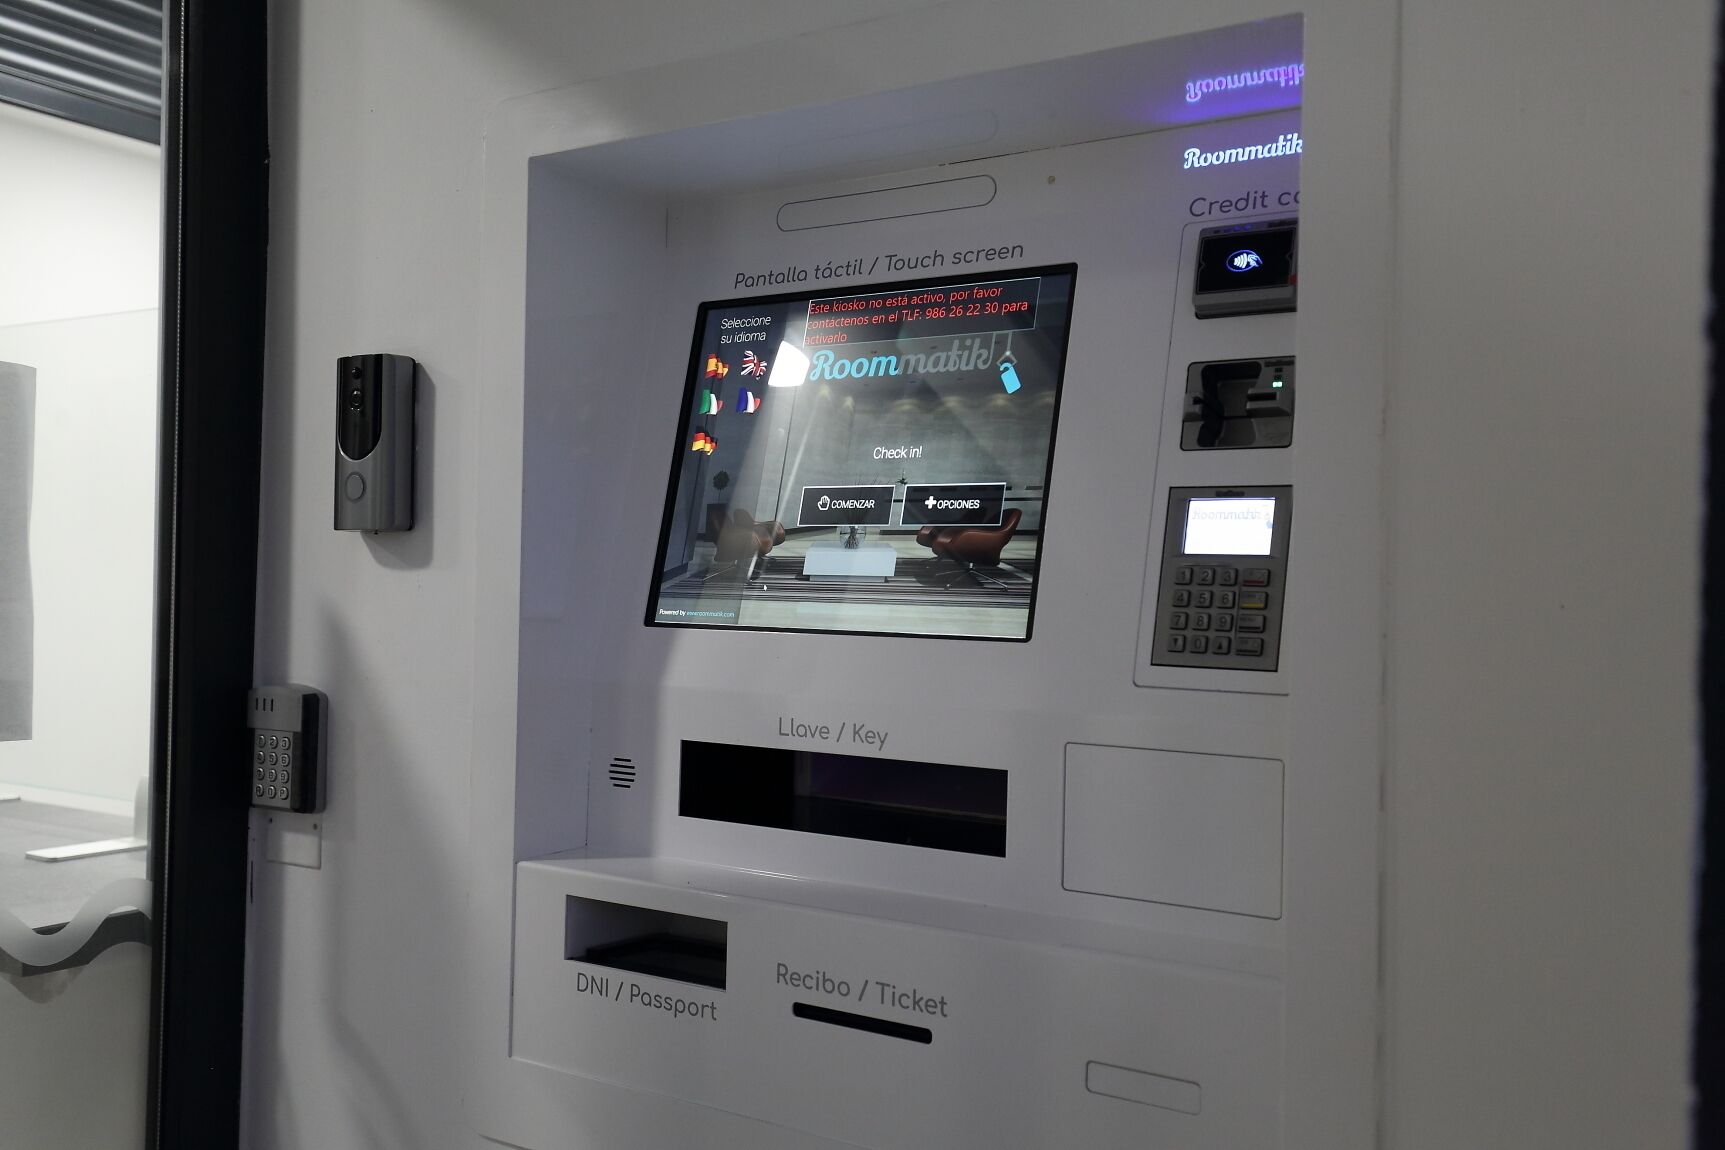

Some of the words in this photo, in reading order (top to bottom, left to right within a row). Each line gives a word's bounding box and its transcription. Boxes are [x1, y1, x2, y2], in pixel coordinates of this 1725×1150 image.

[1184, 133, 1302, 168] Roommatik
[1189, 190, 1269, 217] Credit
[734, 266, 808, 289] Pantalla
[814, 258, 863, 280] táctil
[868, 256, 879, 276] /
[885, 249, 945, 272] Touch
[951, 243, 1024, 265] screen
[808, 303, 830, 314] Este
[832, 299, 866, 312] kiosko
[869, 299, 883, 308] no
[885, 294, 908, 307] está
[910, 292, 945, 304] activo,
[949, 290, 969, 304] por
[973, 287, 1003, 299] favor
[720, 315, 771, 329] Seleccione
[806, 314, 869, 329] contáctenos
[872, 315, 885, 324] en
[888, 310, 898, 322] el
[901, 309, 922, 321] TLF:
[925, 306, 946, 319] 986
[949, 304, 963, 317] 26
[966, 303, 980, 316] 22
[984, 302, 998, 314] 30
[1001, 301, 1028, 315] para
[720, 335, 733, 344] su
[733, 331, 766, 343] idioma
[804, 332, 848, 345] activarlo
[809, 335, 994, 381] Roommatik
[873, 446, 908, 460] Check
[909, 446, 922, 459] in!
[831, 499, 875, 509] COMENZAR
[937, 499, 981, 509] OPCIONES
[778, 717, 830, 743] Llave
[836, 722, 846, 743] /
[852, 723, 889, 751] Key
[576, 972, 610, 999] DNI
[615, 981, 625, 1002] /
[630, 984, 718, 1022] Passport
[776, 962, 852, 998] Recibo
[858, 979, 869, 1002] /
[876, 982, 949, 1018] Ticket
